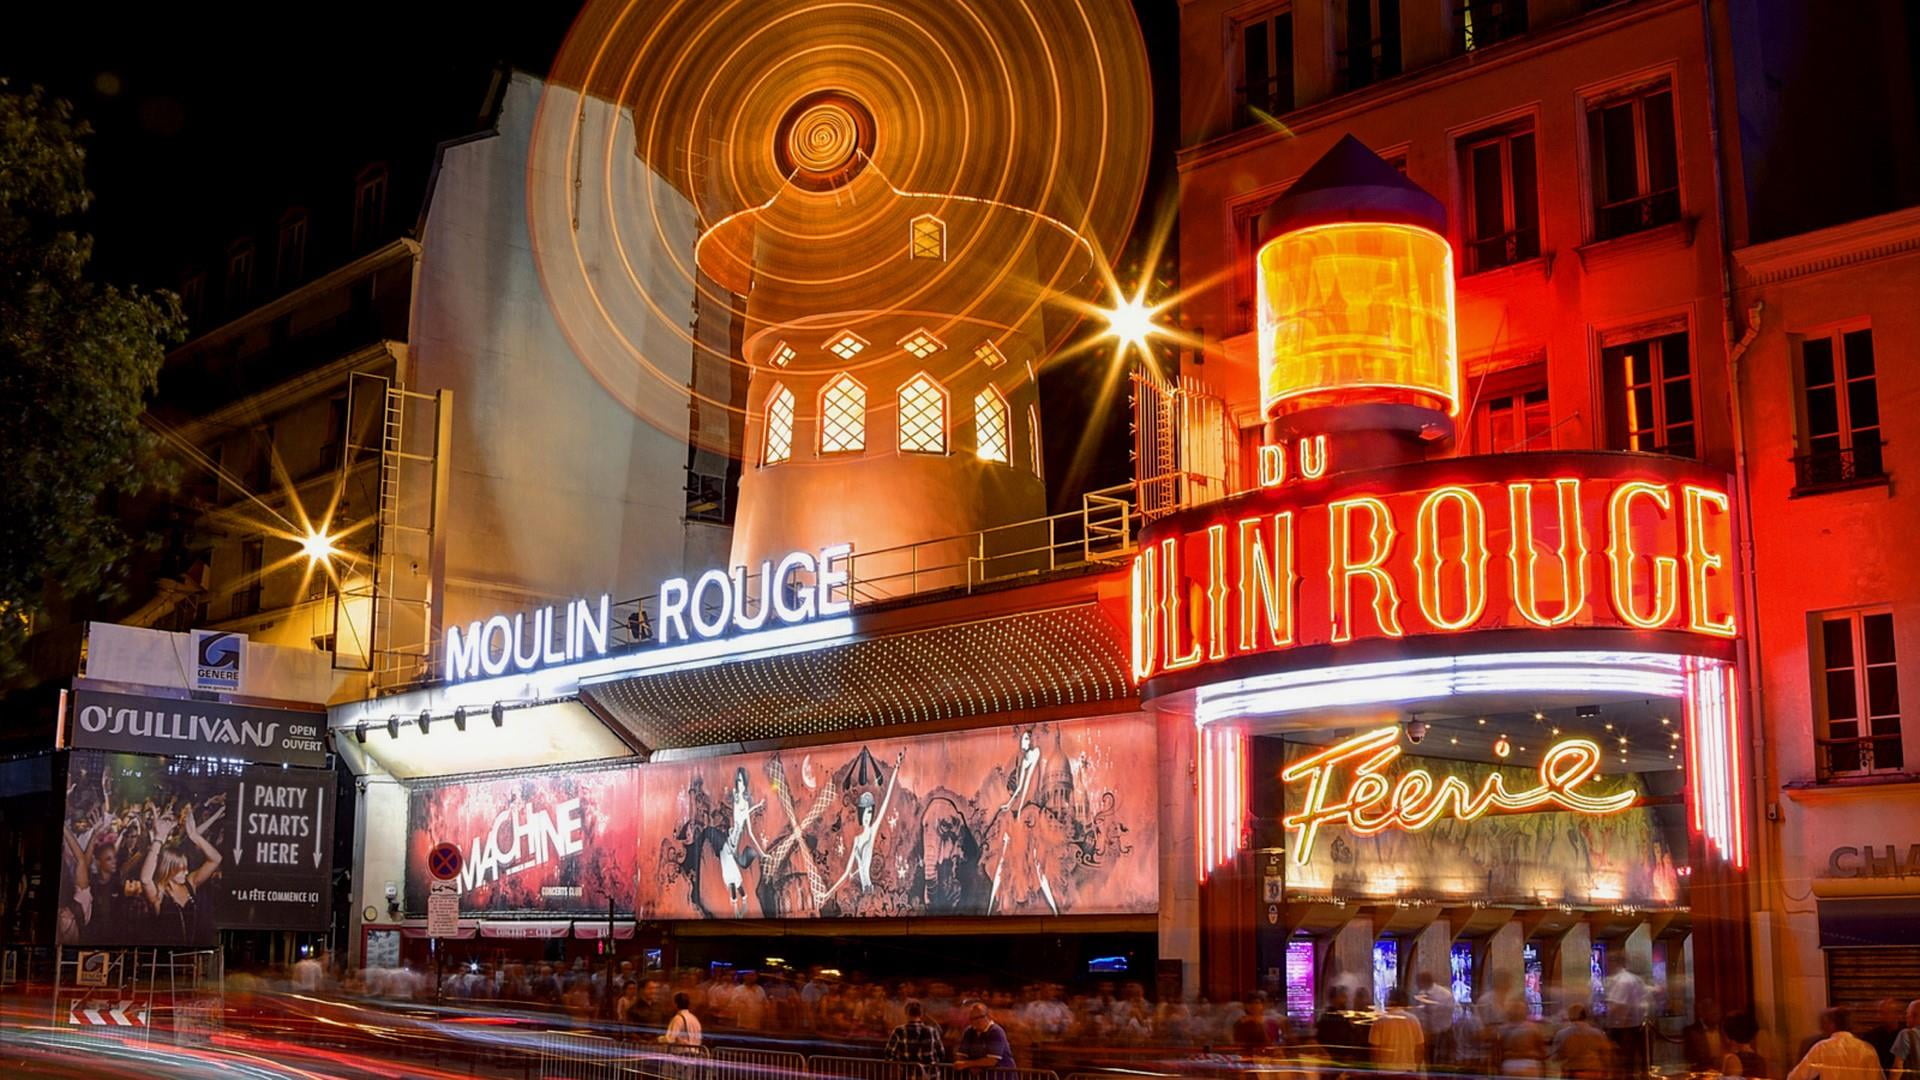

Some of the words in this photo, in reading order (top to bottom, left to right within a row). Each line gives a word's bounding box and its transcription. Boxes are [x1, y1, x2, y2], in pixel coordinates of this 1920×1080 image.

[1259, 436, 1325, 486] DU
[1328, 478, 1737, 642] ROUGE
[445, 592, 611, 682] MOULIN
[658, 543, 853, 644] ROUGE
[197, 669, 240, 680] GENERE
[79, 705, 280, 747] O'SULLIVANS
[289, 724, 317, 737] OPEN
[282, 738, 323, 752] OUVERT
[254, 785, 308, 809] PARTY
[248, 813, 310, 837] STARTS
[256, 842, 299, 865] HERE
[455, 798, 584, 895] MACHINE
[249, 888, 266, 901] FÊTE
[267, 890, 307, 903] COMMENCE
[309, 892, 319, 903] ICI
